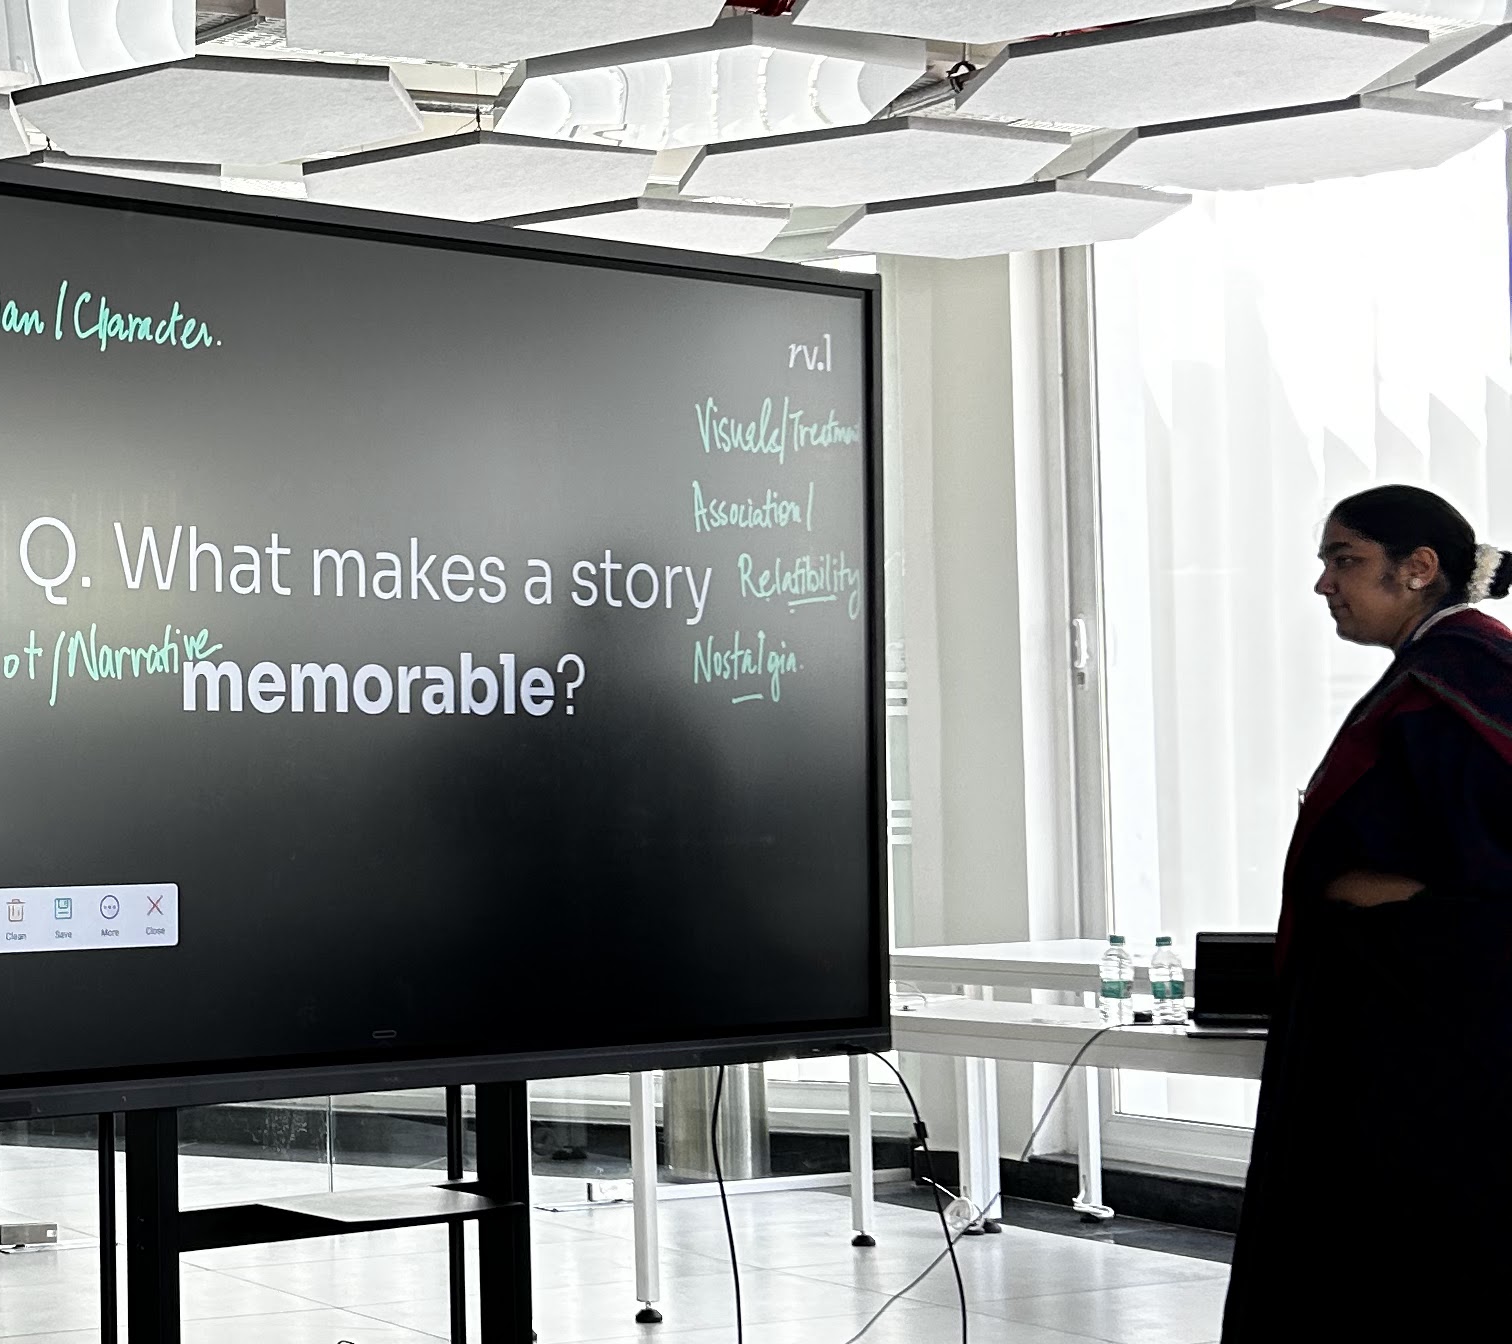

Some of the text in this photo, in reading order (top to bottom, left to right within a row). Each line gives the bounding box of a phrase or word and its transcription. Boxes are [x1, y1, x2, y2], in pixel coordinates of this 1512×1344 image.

[19, 516, 713, 626] Q. What makes a story
[183, 652, 587, 716] memorable?
[54, 930, 73, 939] Save
[145, 926, 166, 935] Close
